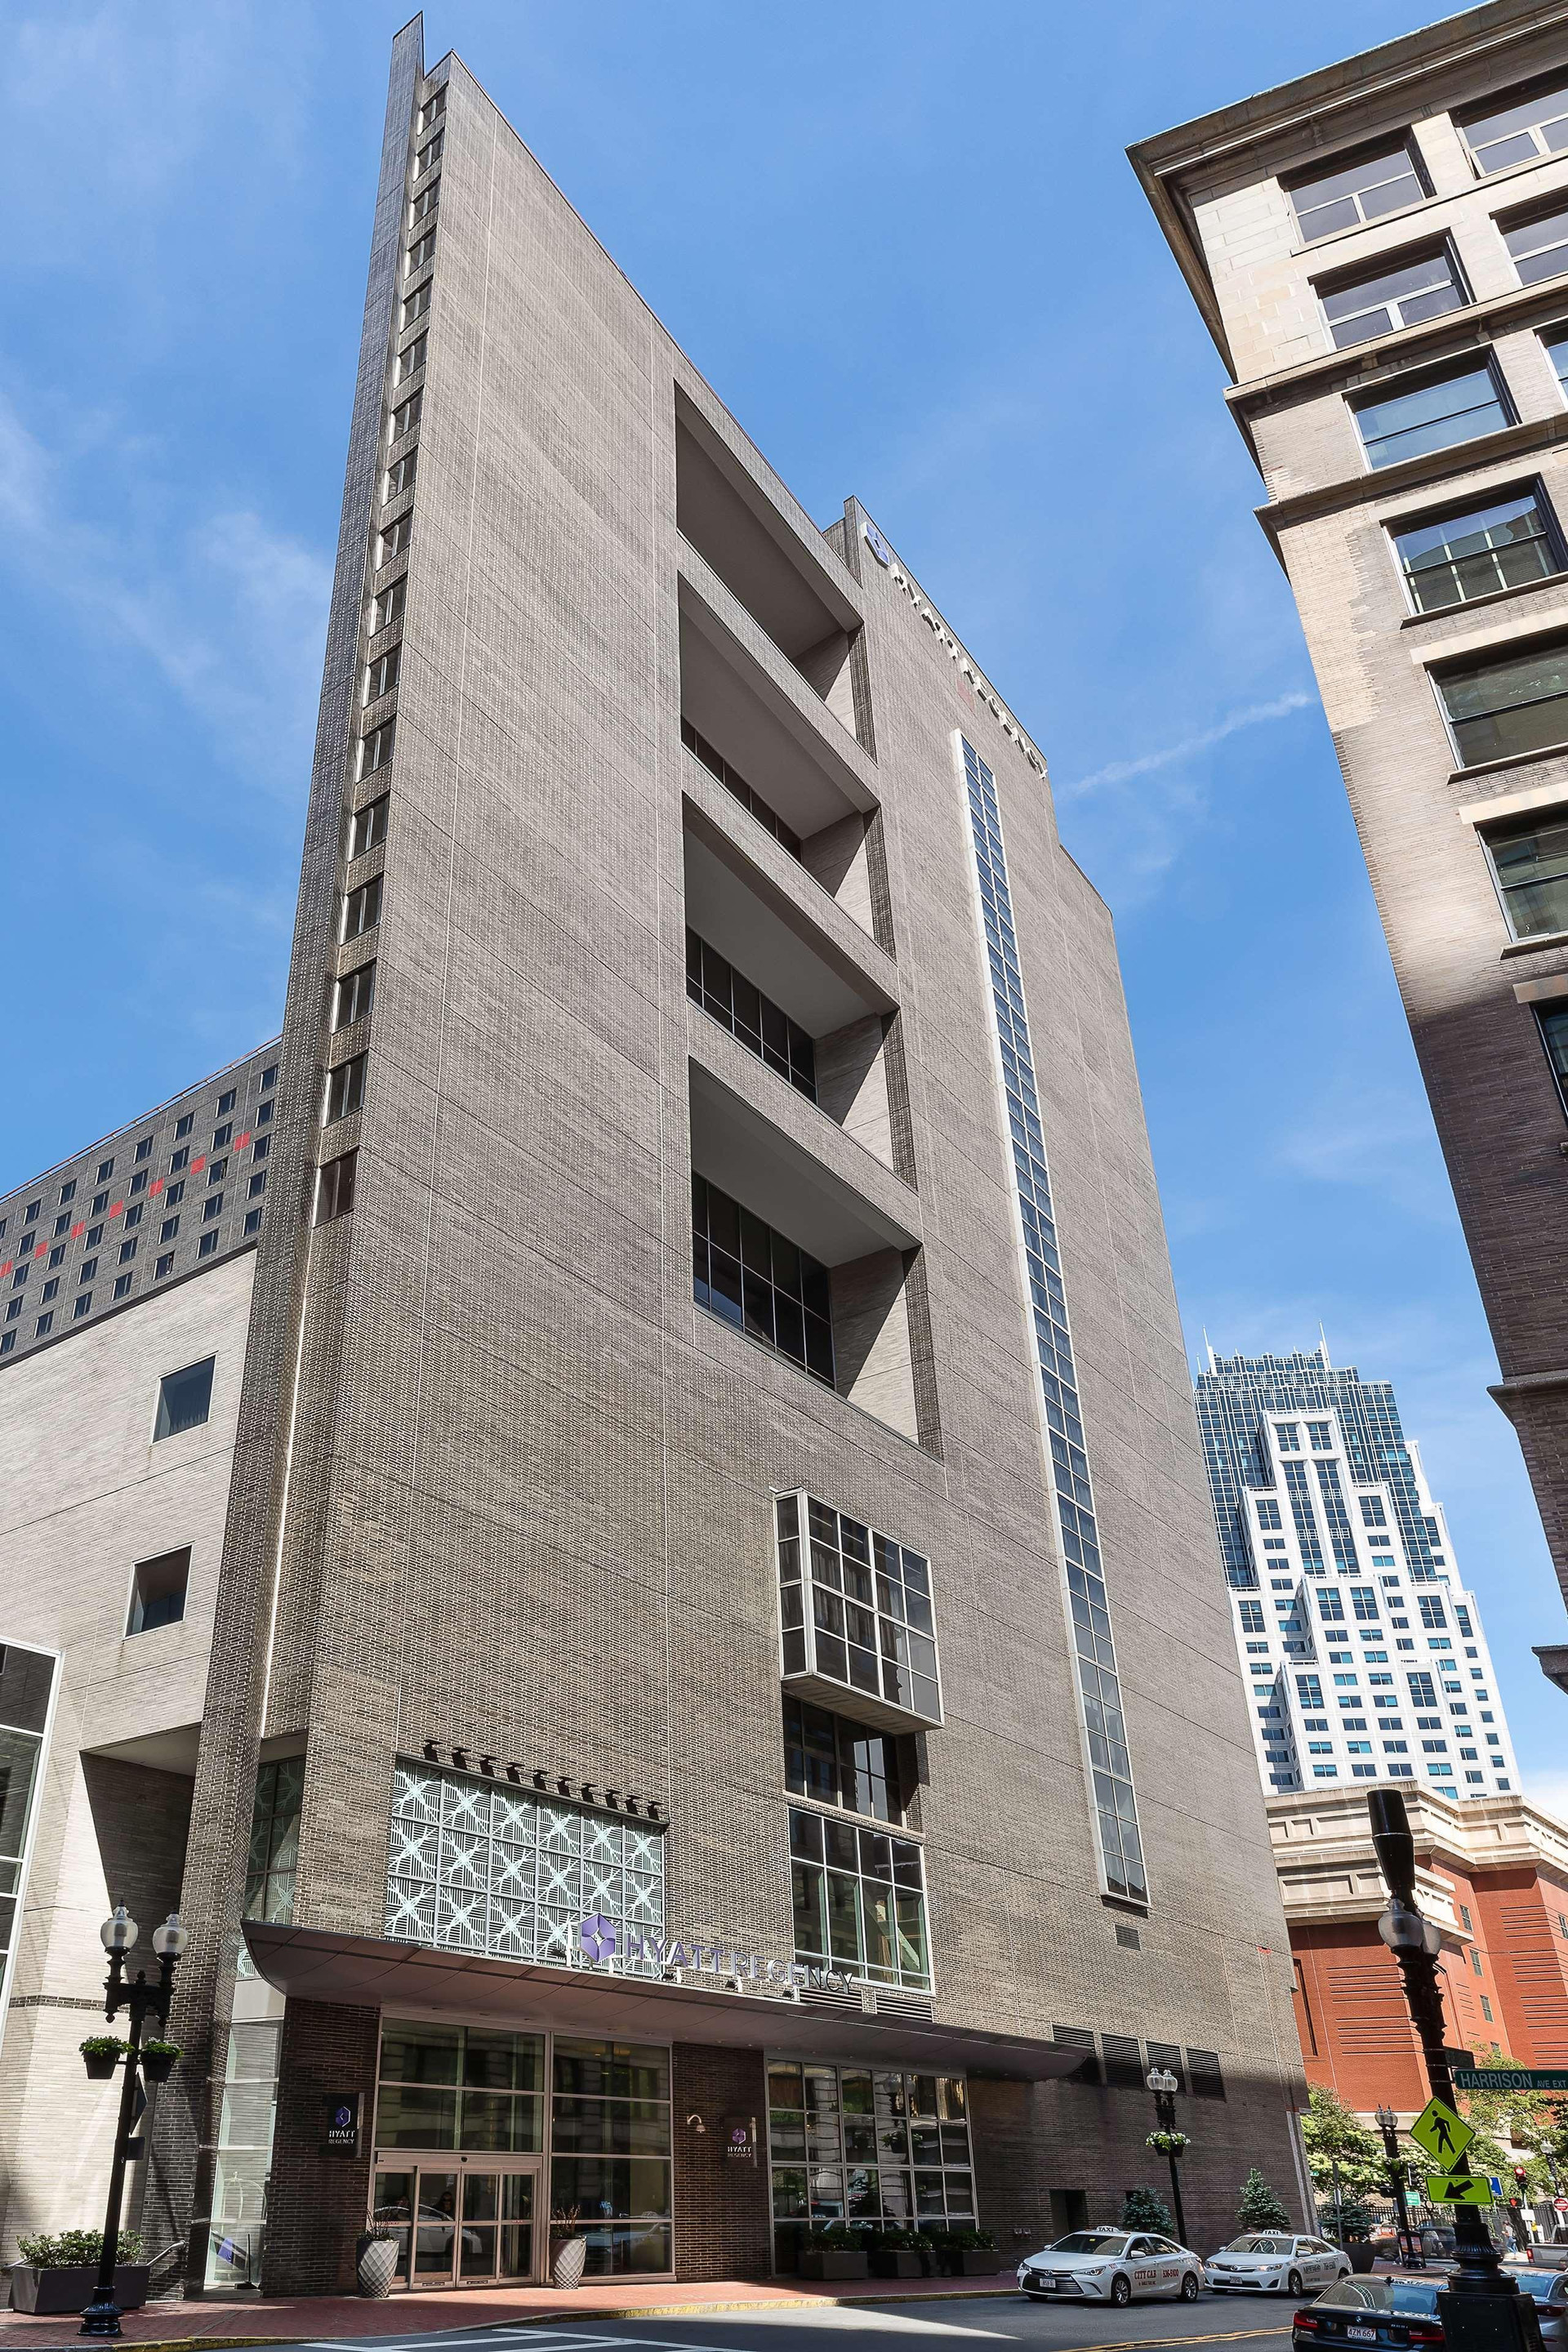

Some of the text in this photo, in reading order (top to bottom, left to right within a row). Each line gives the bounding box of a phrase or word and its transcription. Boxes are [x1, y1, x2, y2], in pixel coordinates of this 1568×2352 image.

[889, 563, 1049, 780] HYATT REGENCY
[626, 1934, 853, 1994] HYATT REGENCY
[1460, 2073, 1567, 2088] HARRISON AVE EXT
[328, 2130, 356, 2138] HYATT
[1134, 2270, 1157, 2280] CITY CAB
[1362, 2330, 1376, 2338] 667
